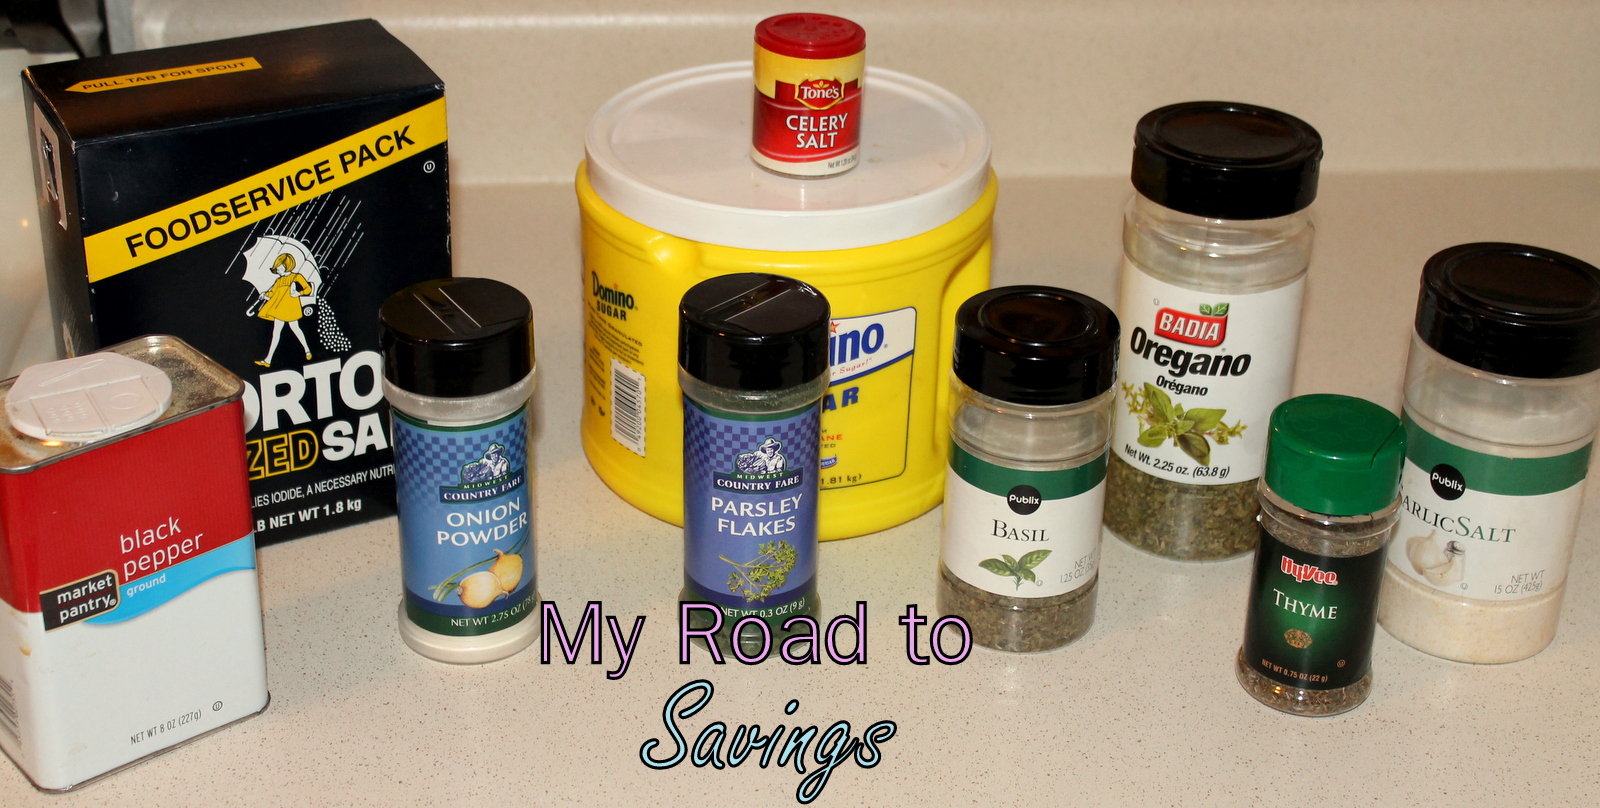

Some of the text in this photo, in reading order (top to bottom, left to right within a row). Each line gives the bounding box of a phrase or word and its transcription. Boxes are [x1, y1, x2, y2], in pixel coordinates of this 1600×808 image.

[82, 62, 246, 90] PULL TAB FOR SPOUT
[801, 85, 840, 101] Tone's
[786, 113, 848, 132] CELERY
[796, 132, 838, 149] SALT
[125, 125, 416, 258] FOODSERVICE PACK
[591, 270, 635, 310] Domino
[596, 300, 627, 321] SUGAR
[1159, 312, 1221, 341] BADIA
[1130, 326, 1252, 378] Oregano
[1156, 375, 1208, 396] Orégano
[246, 413, 394, 480] ZED SA
[1124, 444, 1230, 478] Net Wt. 2.25 oz. (63.8 g)
[306, 484, 313, 496] A
[314, 471, 368, 493] NECESSARY
[443, 475, 522, 501] COUNTRY FARE
[463, 475, 509, 489] MIDWEST
[716, 475, 799, 491] COUNTRY FARE
[736, 472, 784, 480] MIDWEST
[1432, 472, 1464, 492] Publix
[446, 497, 520, 527] ONION
[711, 493, 803, 518] PARSLEY
[1009, 494, 1040, 505] Publix
[1401, 484, 1455, 533] ARLIC
[253, 499, 362, 533] B NET WT 1.8 kg
[717, 516, 796, 537] FLAKES
[120, 516, 182, 554] black
[437, 512, 528, 546] POWDER
[122, 532, 204, 581] pepper
[1074, 555, 1087, 569] NET
[57, 573, 113, 604] market
[126, 573, 167, 598] ground
[1511, 569, 1545, 584] NET WT
[1494, 584, 1502, 595] 15
[1504, 584, 1519, 594] OZ
[451, 618, 471, 627] NET
[472, 616, 489, 626] WT
[491, 610, 509, 623] 2.75
[510, 603, 522, 616] OZ
[720, 607, 739, 618] NET
[760, 609, 773, 618] 0.3
[775, 605, 789, 616] OZ
[1273, 588, 1338, 620] THYME
[1262, 658, 1273, 669] NET
[1273, 664, 1283, 674] WT
[1283, 668, 1298, 679] 0.75
[1299, 672, 1308, 680] OZ
[130, 709, 202, 745] NET WT 8 OZ (227g)
